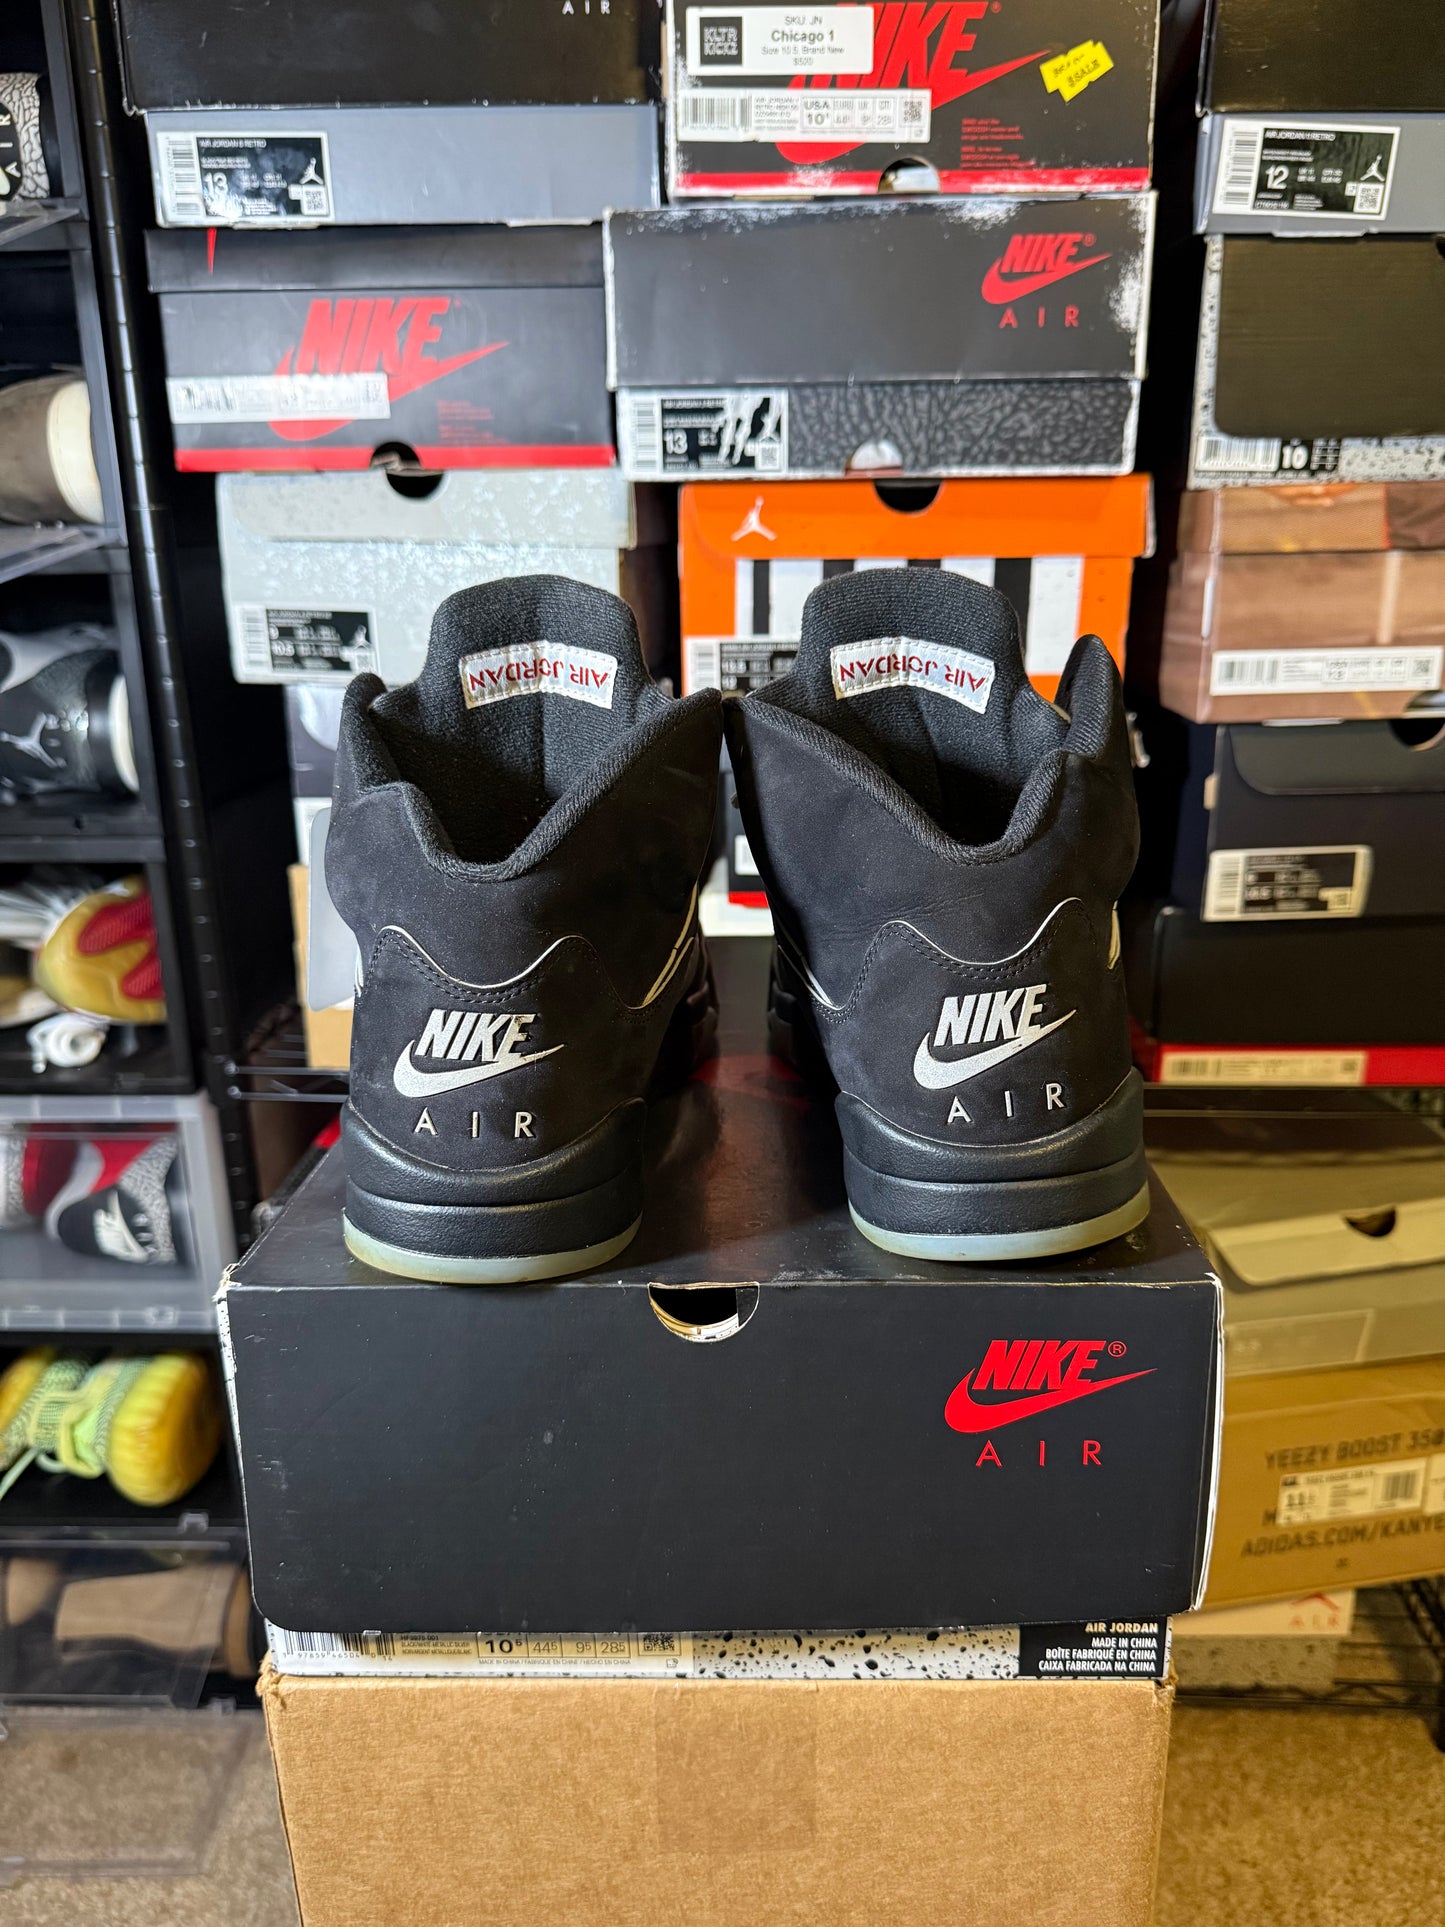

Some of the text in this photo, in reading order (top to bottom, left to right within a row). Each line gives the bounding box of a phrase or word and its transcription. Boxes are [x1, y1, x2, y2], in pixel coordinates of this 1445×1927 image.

[562, 0, 610, 15] AIR
[771, 30, 835, 43] Chicago 1
[804, 101, 831, 110] USA
[203, 172, 228, 196] 13
[1265, 165, 1290, 190] 12
[1000, 232, 1083, 274] NIKE
[998, 305, 1080, 329] AIR
[295, 297, 450, 376] NIKE
[664, 429, 688, 455] 13
[1281, 444, 1308, 470] 10
[469, 657, 609, 691] AIR JORDAN
[839, 653, 986, 693] AIR JORDAN
[933, 983, 1047, 1047] NIKE
[414, 1008, 537, 1062] NIKE
[947, 1082, 1065, 1123] AIR
[414, 1107, 536, 1138] AIR
[975, 1439, 1102, 1467] AIR
[1265, 1444, 1331, 1469] YEEZY
[1336, 1432, 1402, 1460] BOOST
[1085, 1622, 1159, 1633] AIR JORDAN
[1045, 1646, 1157, 1661] BOÎTE FABRIQUÉ EN CHINA
[1092, 1637, 1158, 1649] MADE IN CHINA
[1038, 1660, 1156, 1671] CAIXA FABRICADA NA CHINA
